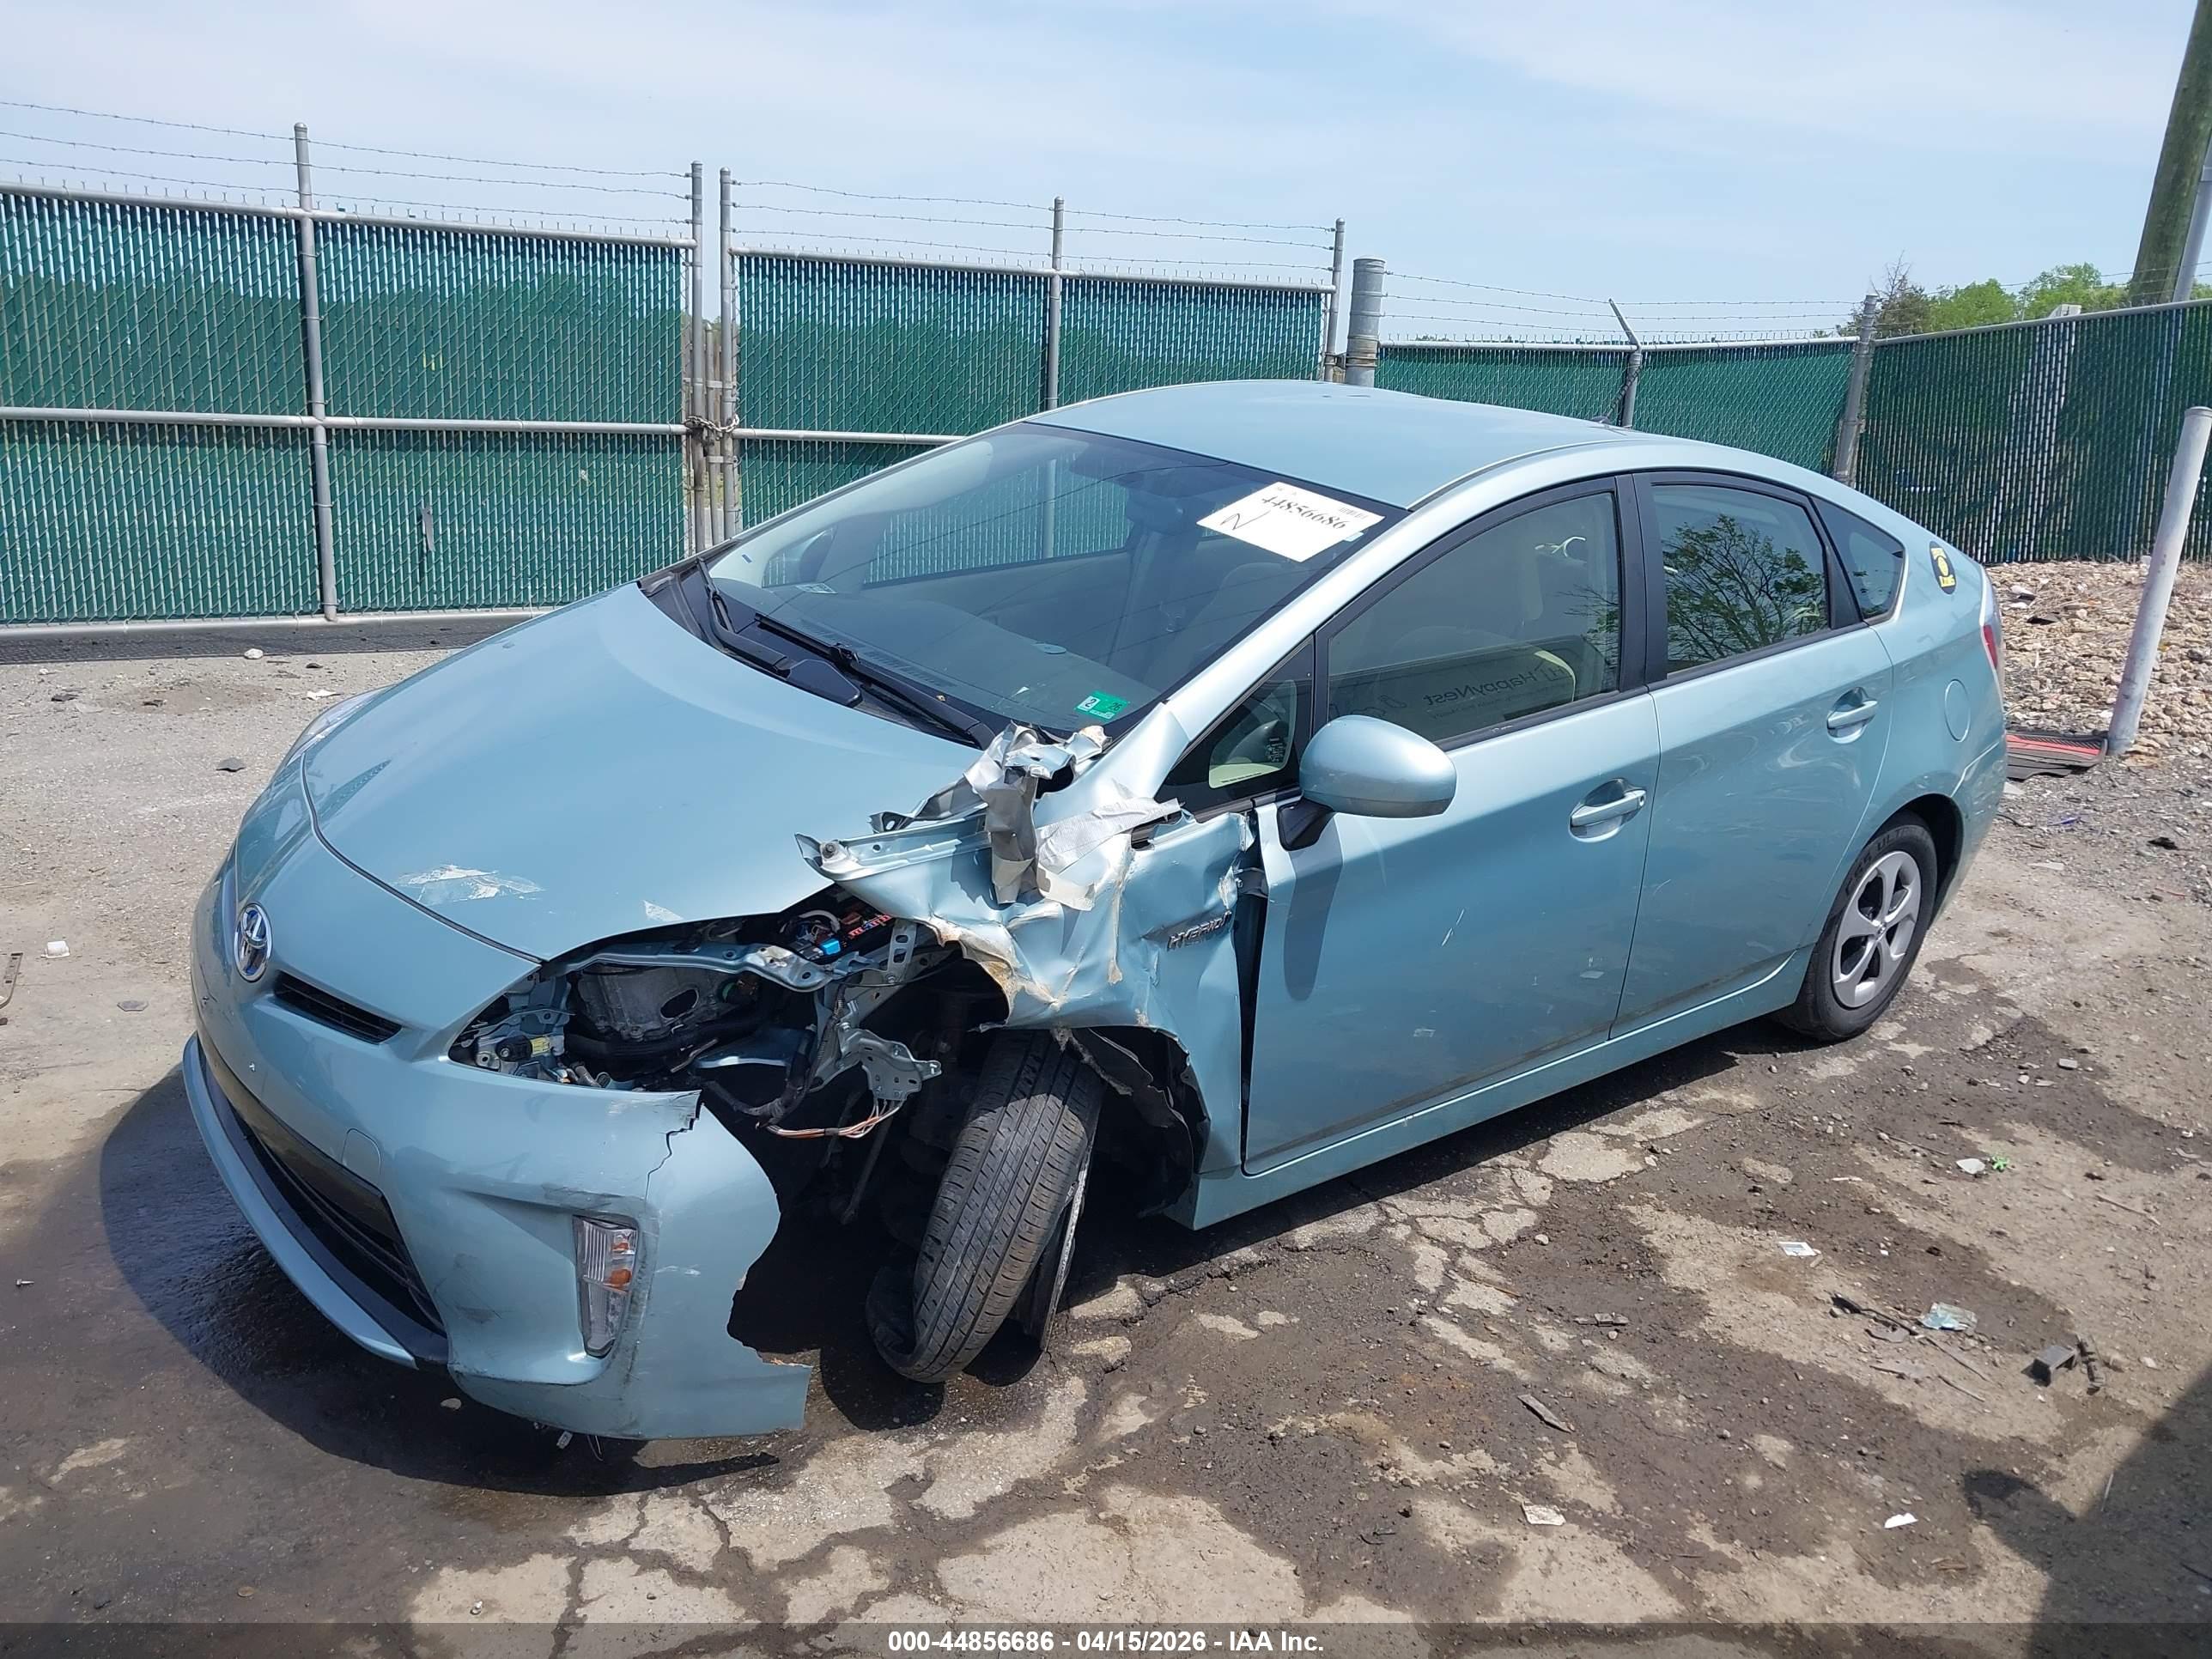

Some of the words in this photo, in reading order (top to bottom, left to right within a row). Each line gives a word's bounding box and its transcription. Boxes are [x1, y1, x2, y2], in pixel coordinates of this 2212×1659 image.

[1261, 495, 1349, 530] 44856686
[1085, 698, 1097, 708] 2
[1167, 909, 1232, 951] HYBRID
